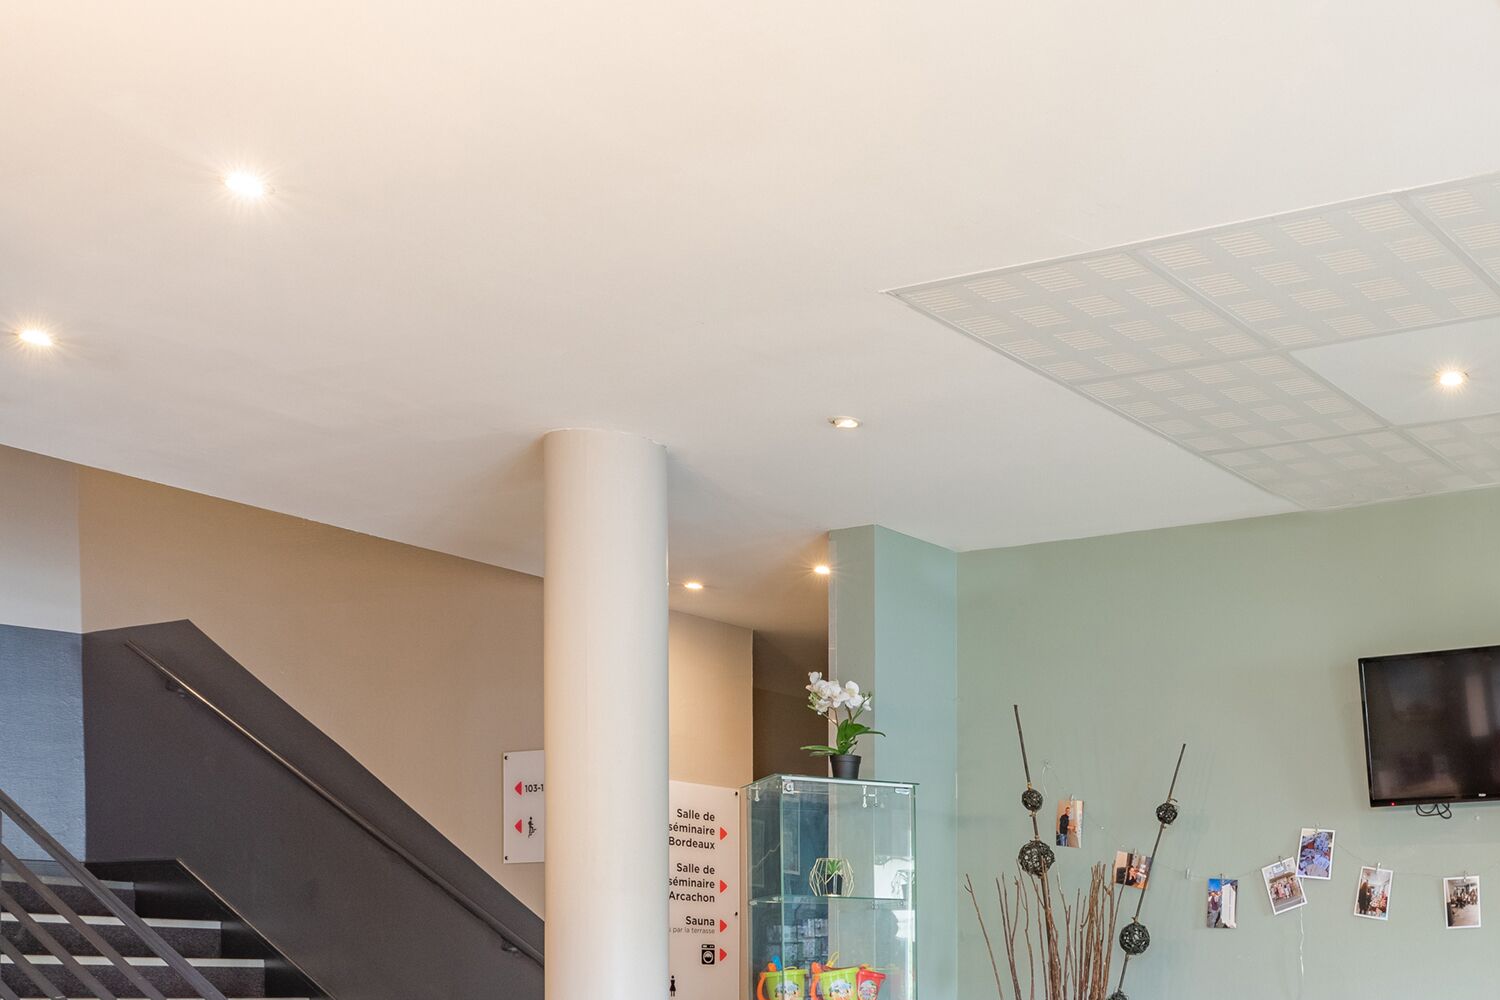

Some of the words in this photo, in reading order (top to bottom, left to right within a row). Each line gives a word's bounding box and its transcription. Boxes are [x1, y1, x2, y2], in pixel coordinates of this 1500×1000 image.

[676, 808, 700, 820] Salle
[703, 812, 715, 821] de
[669, 822, 715, 836] séminaire
[669, 836, 715, 850] Bordeaux
[676, 862, 700, 874] Salle
[703, 865, 715, 875] de
[669, 876, 715, 889] séminaire
[668, 890, 715, 903] Arcachon
[685, 915, 715, 926] Sauna
